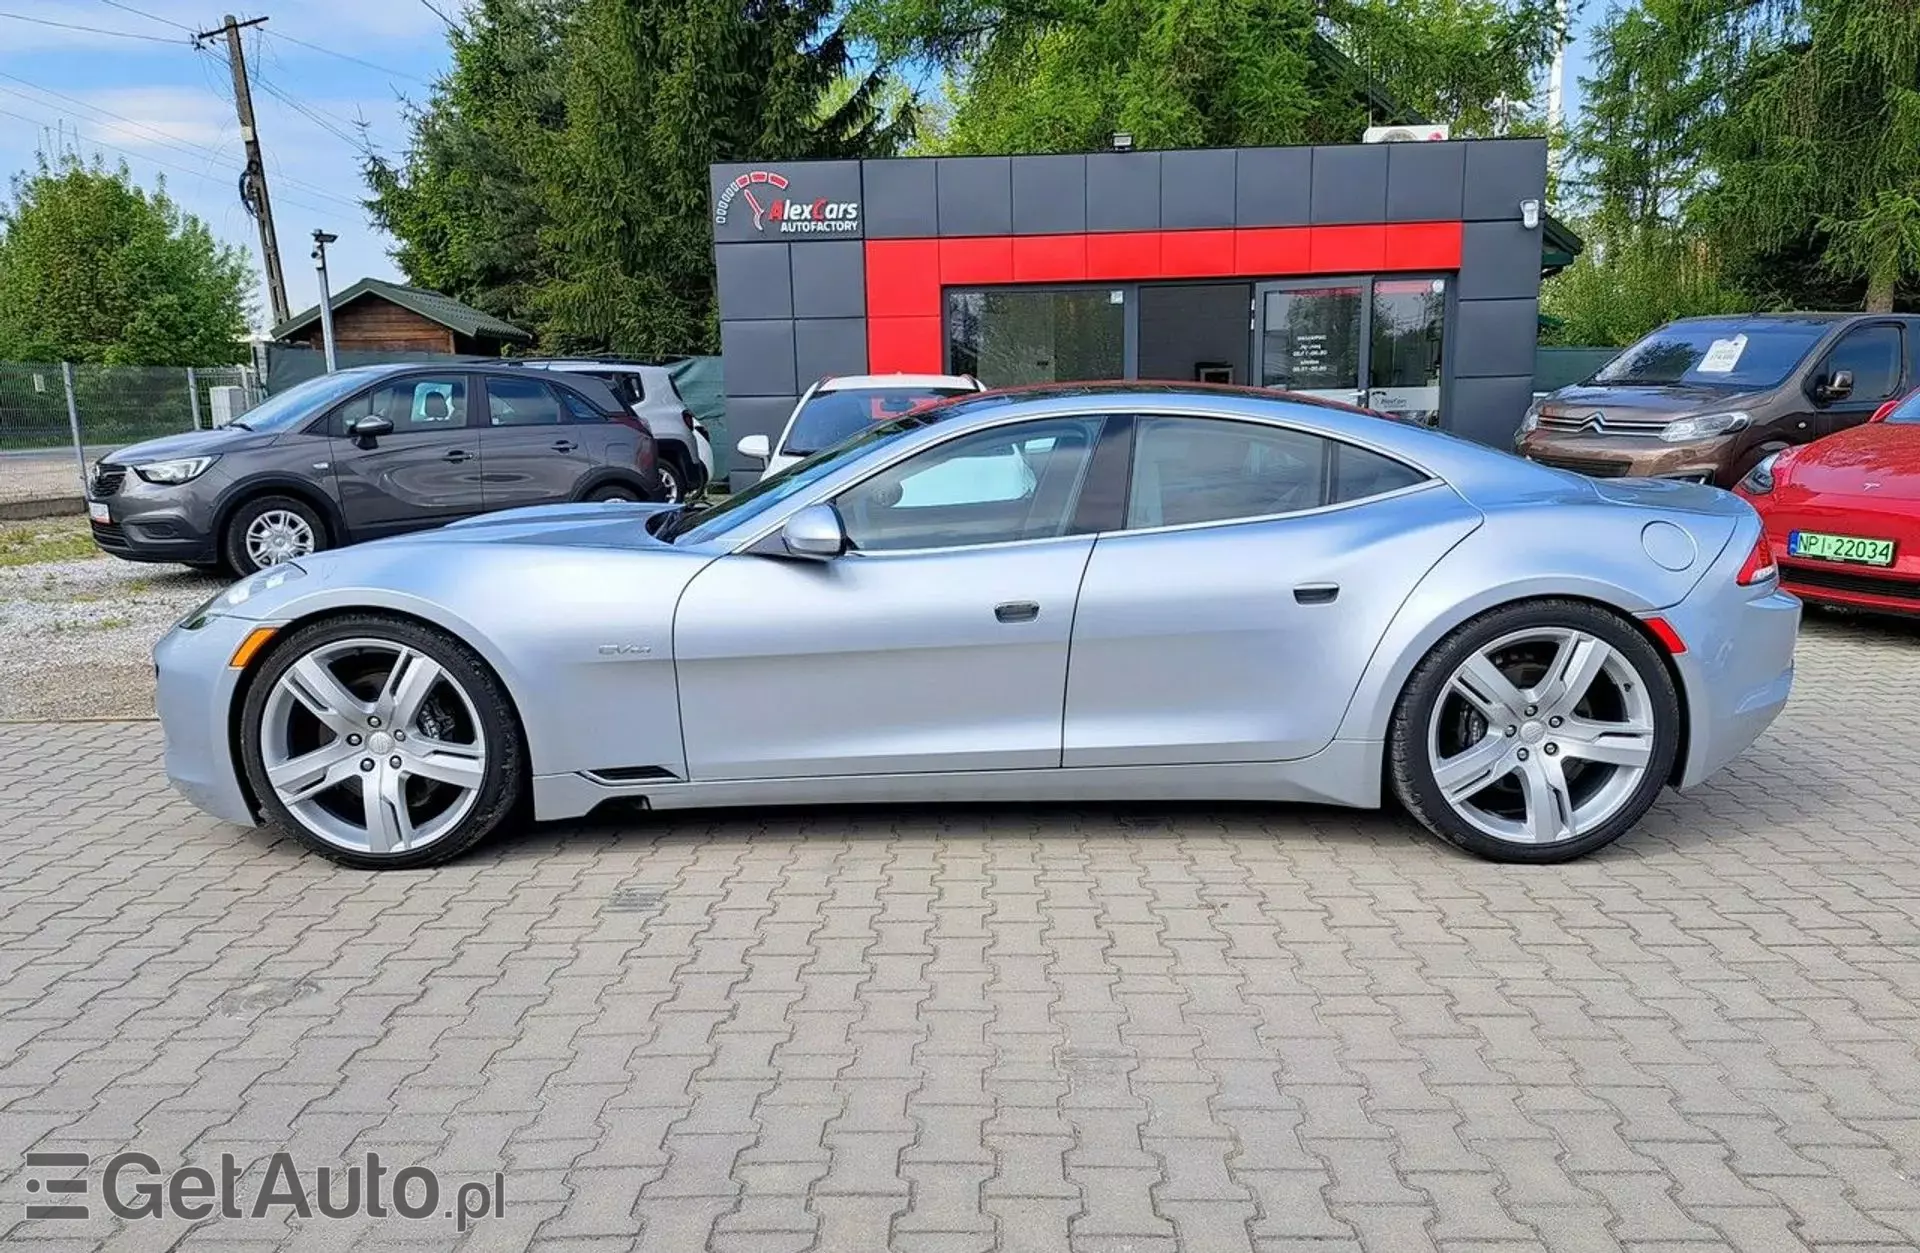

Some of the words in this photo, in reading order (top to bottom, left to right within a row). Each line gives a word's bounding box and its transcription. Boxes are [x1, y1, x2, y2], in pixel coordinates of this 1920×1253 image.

[769, 198, 857, 221] AlexCars
[781, 221, 858, 232] AUTOFACTORY
[1799, 535, 1826, 554] NPI
[1833, 538, 1891, 560] 22034
